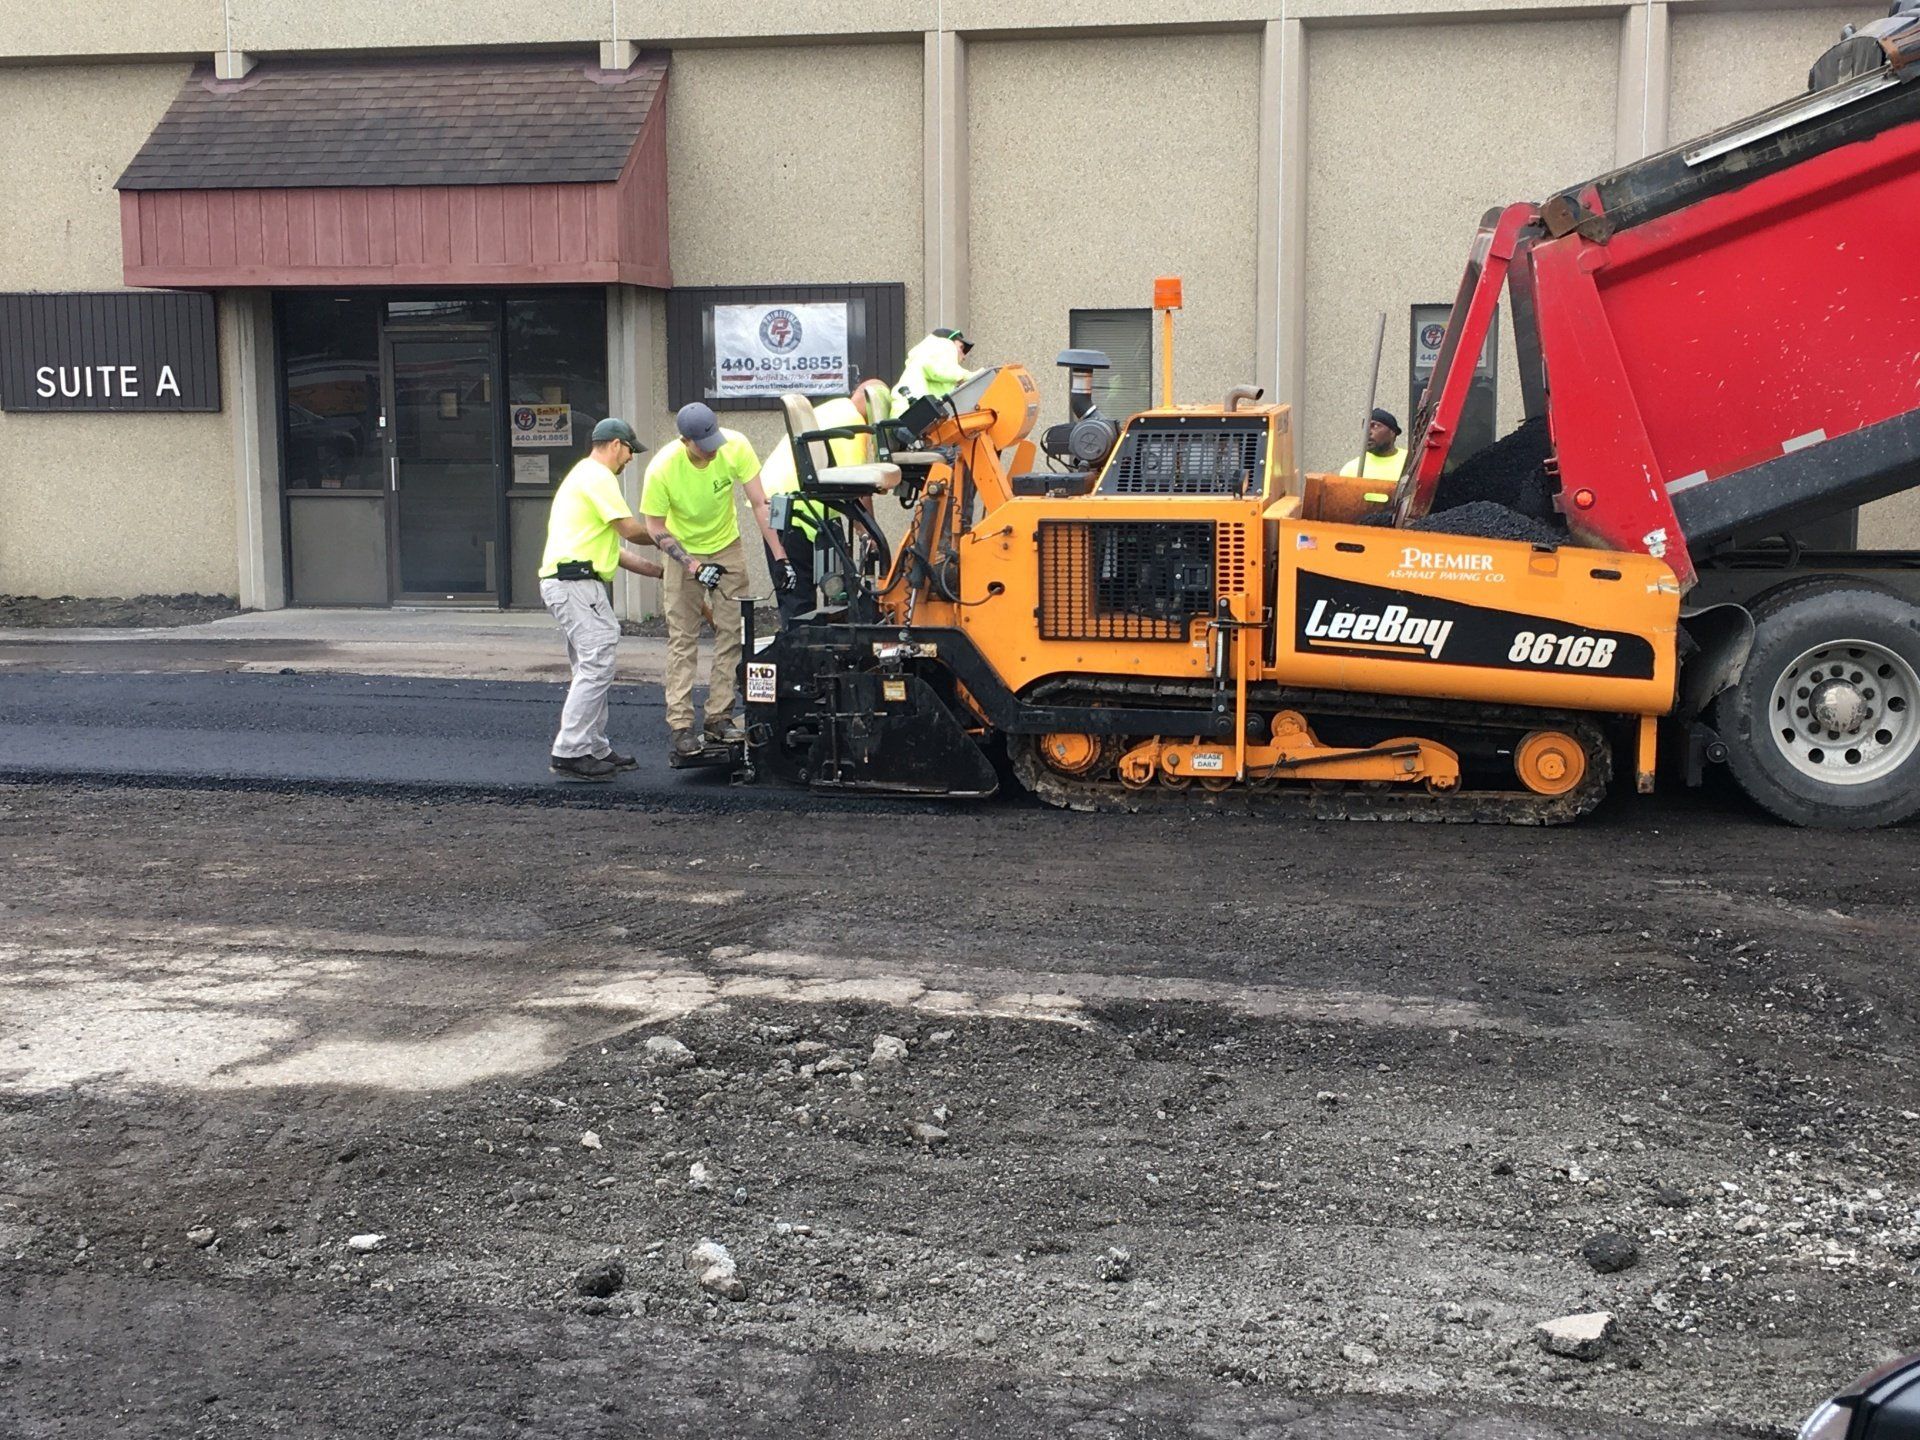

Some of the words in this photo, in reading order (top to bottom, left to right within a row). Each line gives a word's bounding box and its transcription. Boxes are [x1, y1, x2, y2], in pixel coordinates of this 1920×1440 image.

[721, 356, 843, 371] 440.891.8855
[36, 366, 138, 398] SUITE
[156, 365, 181, 397] A
[1398, 547, 1494, 570] PREMIER
[1387, 569, 1436, 580] ASPHALT
[1439, 571, 1482, 582] PAVING
[1485, 573, 1506, 583] CO.
[1304, 599, 1454, 659] LeeBoy
[1507, 631, 1618, 669] 8616B
